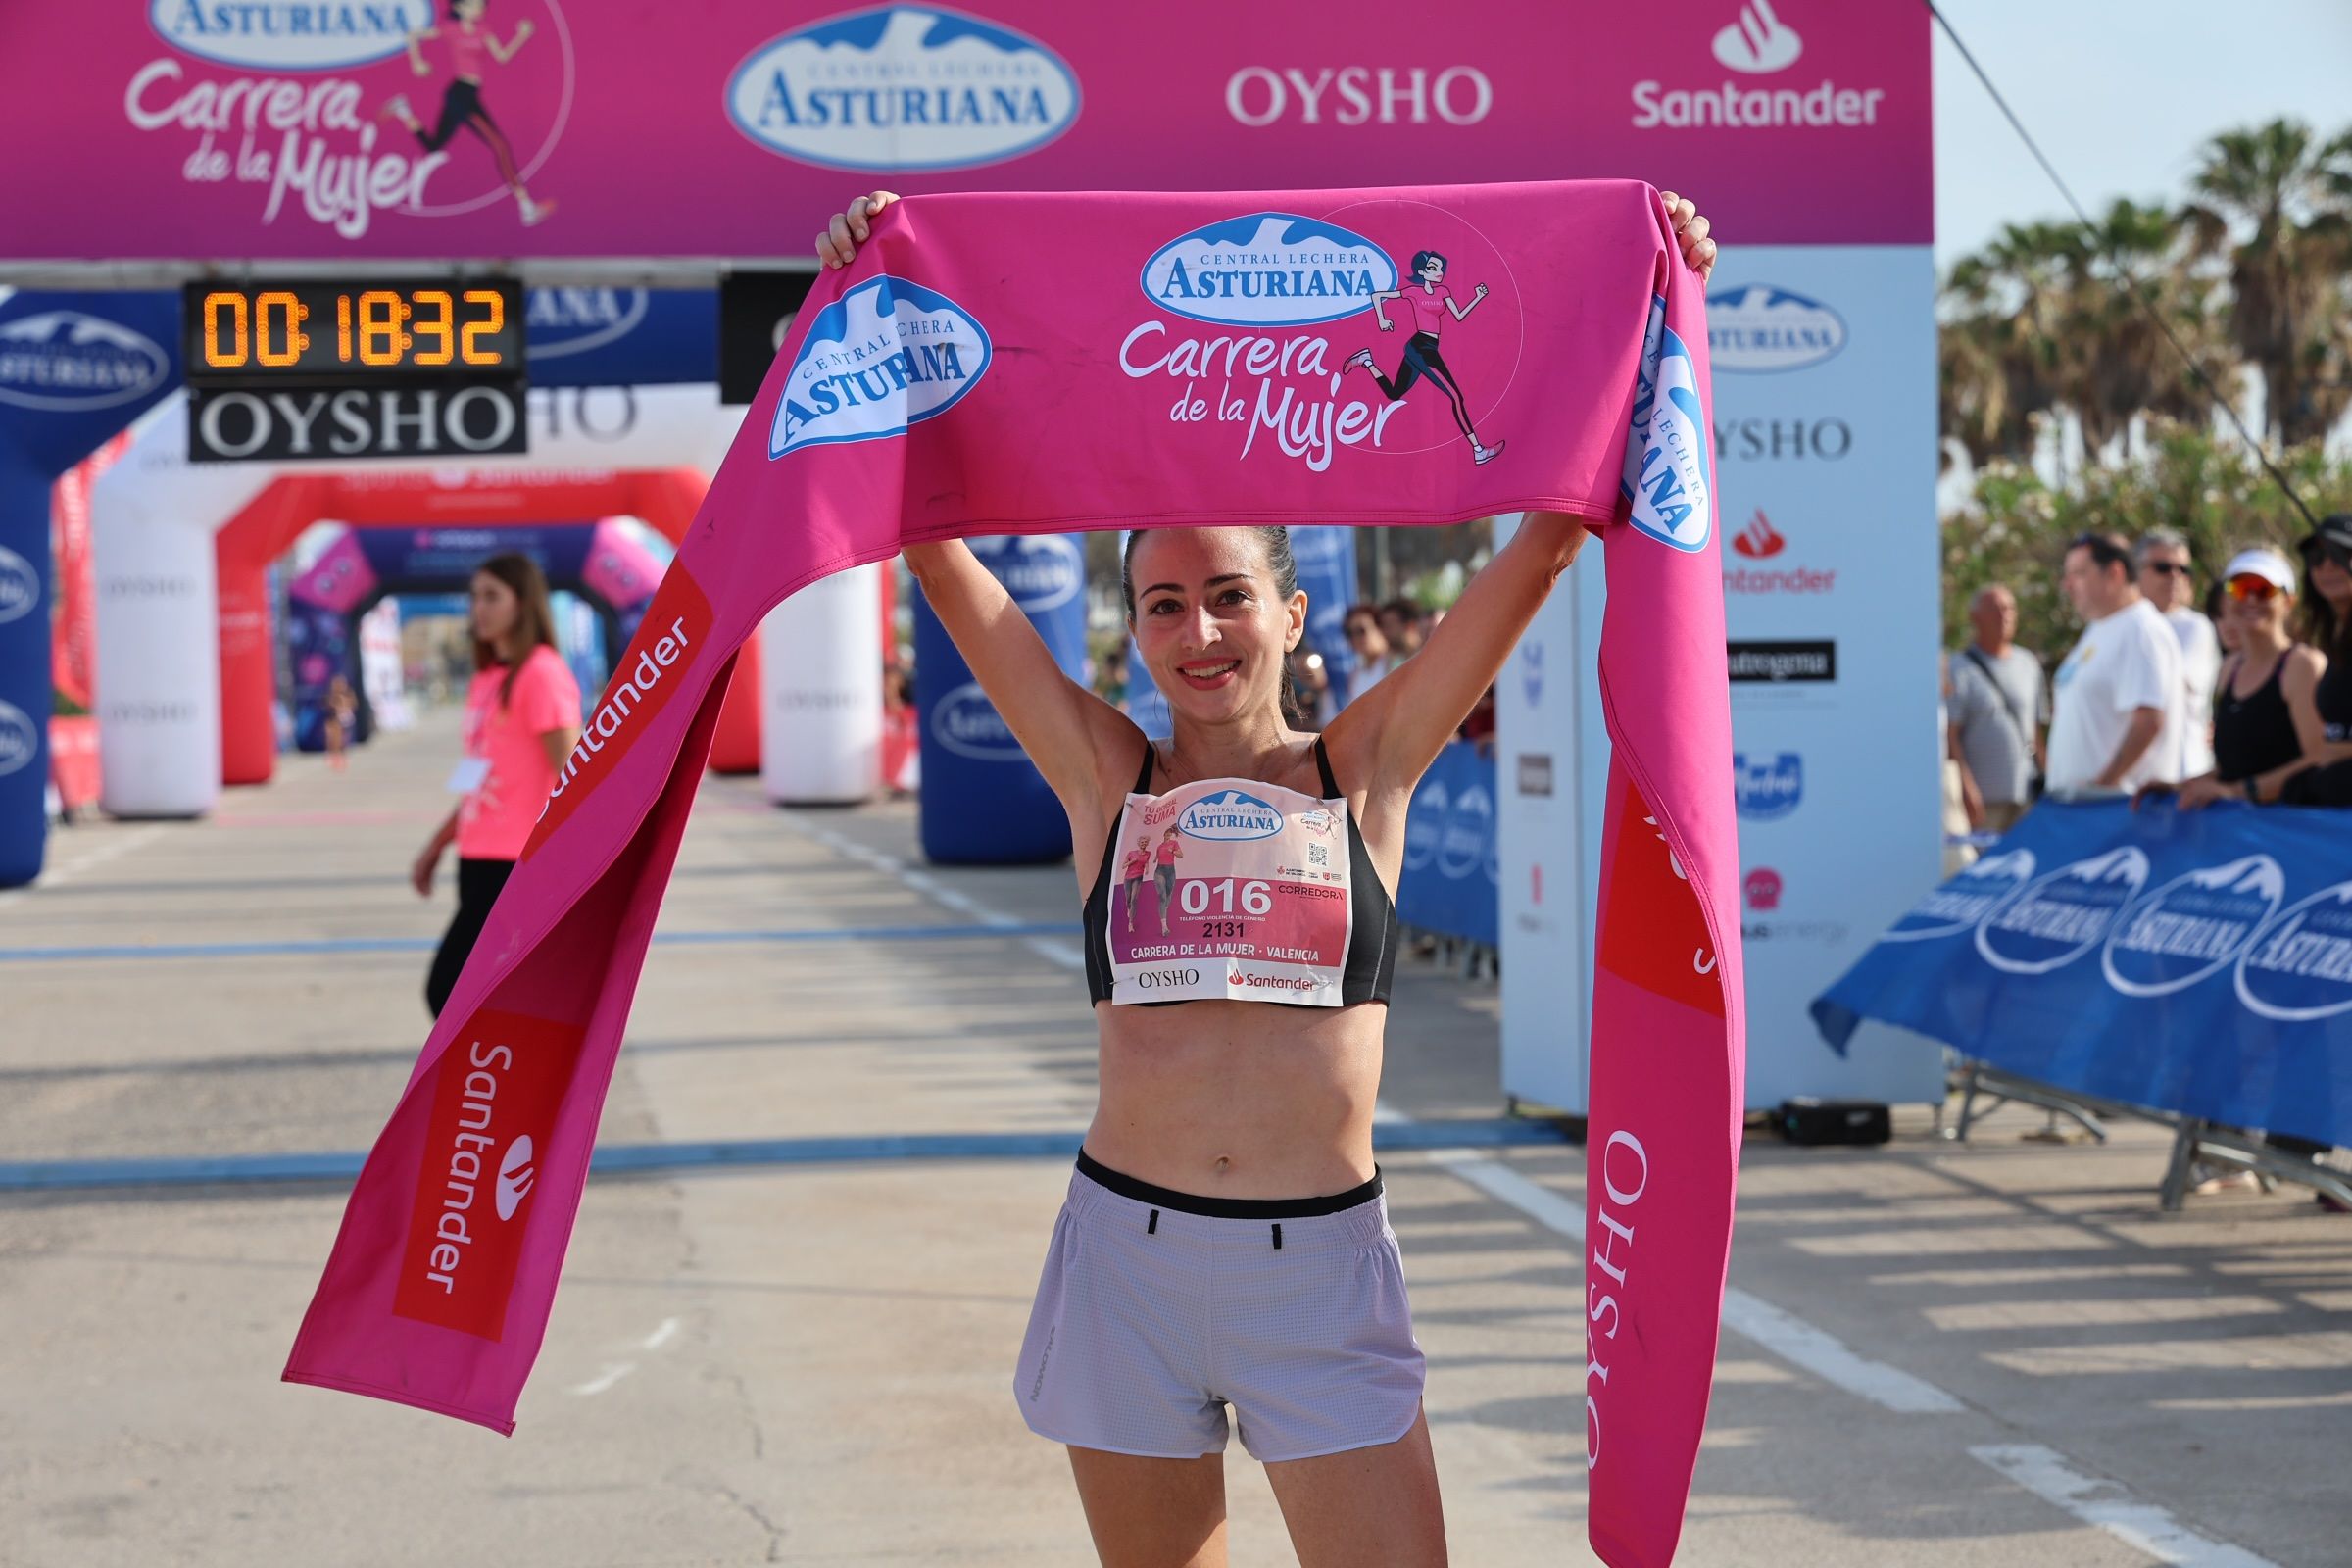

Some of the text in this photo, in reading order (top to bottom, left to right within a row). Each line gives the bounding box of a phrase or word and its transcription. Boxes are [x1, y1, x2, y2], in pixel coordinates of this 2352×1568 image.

[124, 57, 363, 131] Carrera
[758, 68, 1050, 128] ASTURIANA
[1225, 65, 1494, 126] OYSHO
[1631, 79, 1885, 128] Santander
[183, 122, 450, 239] de la Mujer
[1160, 257, 1372, 299] ASTURIANA
[1200, 252, 1369, 266] CENTRAL LECHERA
[204, 291, 504, 367] 00:18:32
[1119, 320, 1330, 378] Carrera
[803, 333, 891, 380] CENTRAL
[200, 386, 516, 458] OYSHO
[1170, 371, 1407, 472] de la Mujer
[1713, 416, 1853, 462] YSHO
[1652, 408, 1704, 506] LECHERA
[1722, 564, 1838, 594] ntander
[1143, 808, 1176, 825] SUMA
[1145, 805, 1154, 813] TU
[1184, 810, 1276, 830] ASTURIANA
[1180, 879, 1271, 915] 016
[1278, 885, 1344, 900] CORREDORA
[1131, 943, 1319, 961] CARRERA DE LA MUJER VALENCIA
[1202, 922, 1244, 937] 2131
[1139, 968, 1200, 989] OYSHO
[1246, 973, 1315, 991] Santander
[427, 1041, 512, 1295] Santander
